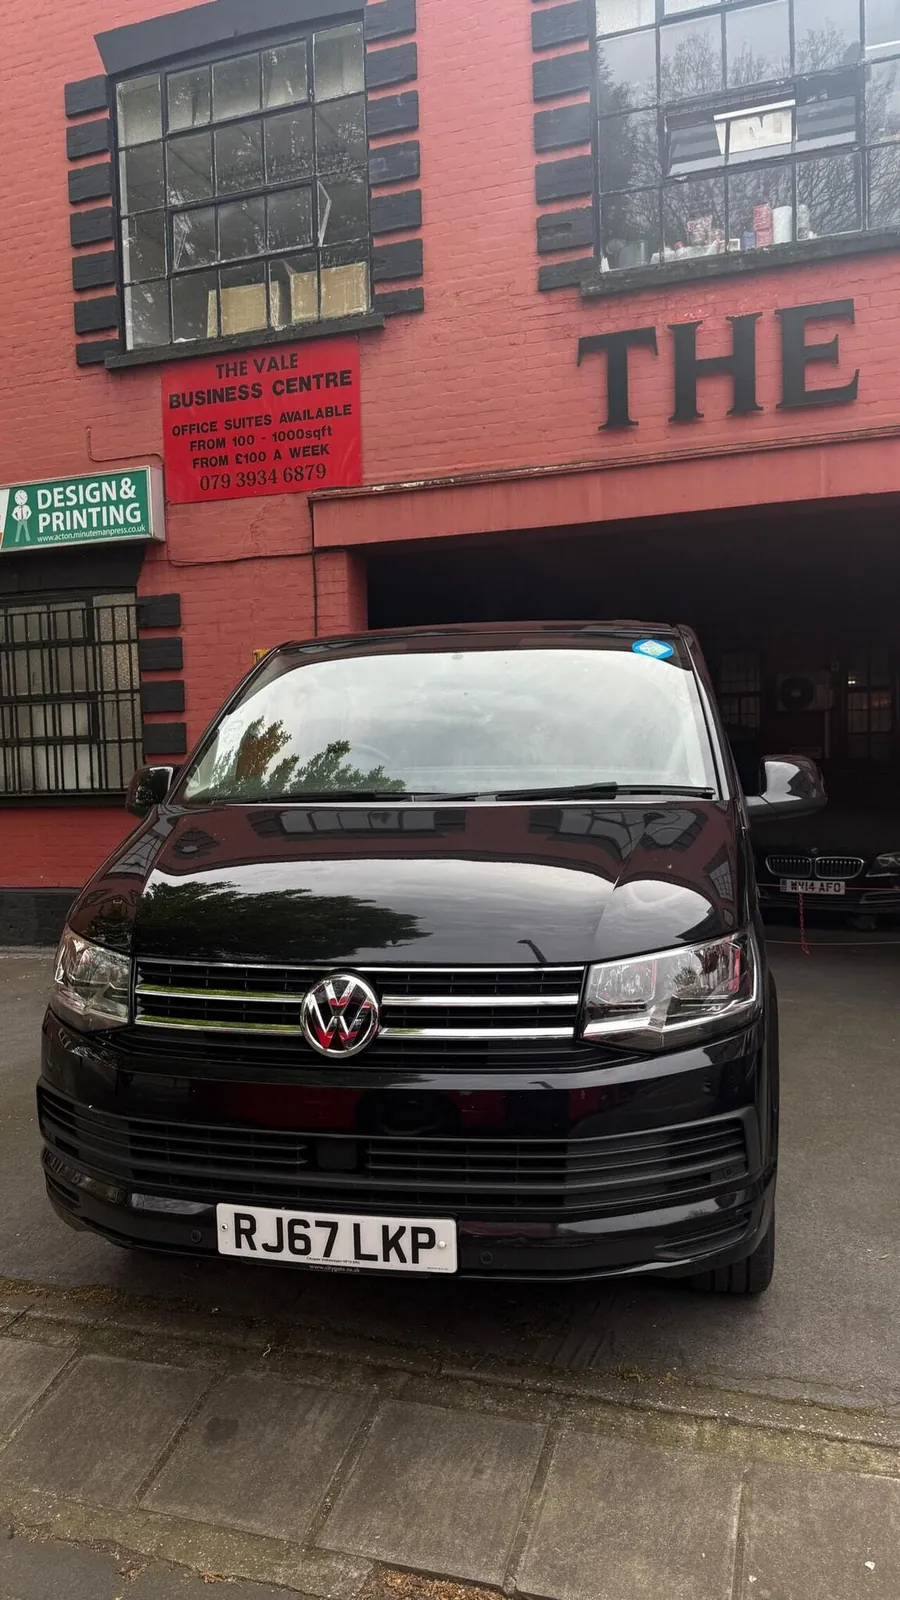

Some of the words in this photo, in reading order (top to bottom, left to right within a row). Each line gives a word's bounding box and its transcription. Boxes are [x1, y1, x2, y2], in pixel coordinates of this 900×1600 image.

[216, 361, 248, 379] THE
[253, 353, 298, 374] VALE
[577, 298, 859, 431] THE
[169, 383, 262, 409] BUSINESS
[272, 370, 352, 396] CENTRE
[172, 421, 217, 436] OFFICE
[224, 414, 272, 430] SUITES
[279, 404, 352, 424] AVAILABLE
[190, 438, 226, 451] FROM
[232, 435, 254, 447] 100
[272, 425, 332, 443] 1000sqft
[193, 456, 228, 469] FROM
[235, 452, 266, 464] £100
[273, 450, 282, 461] A
[289, 444, 330, 459] WEEK
[200, 474, 231, 491] 079
[236, 470, 277, 488] 3934
[283, 463, 326, 482] 6879
[38, 503, 141, 533] PRINTING
[37, 524, 146, 542] www.acton.minutemanpress.co.uk
[234, 1212, 338, 1258] RJ67
[353, 1223, 436, 1264] LKP
